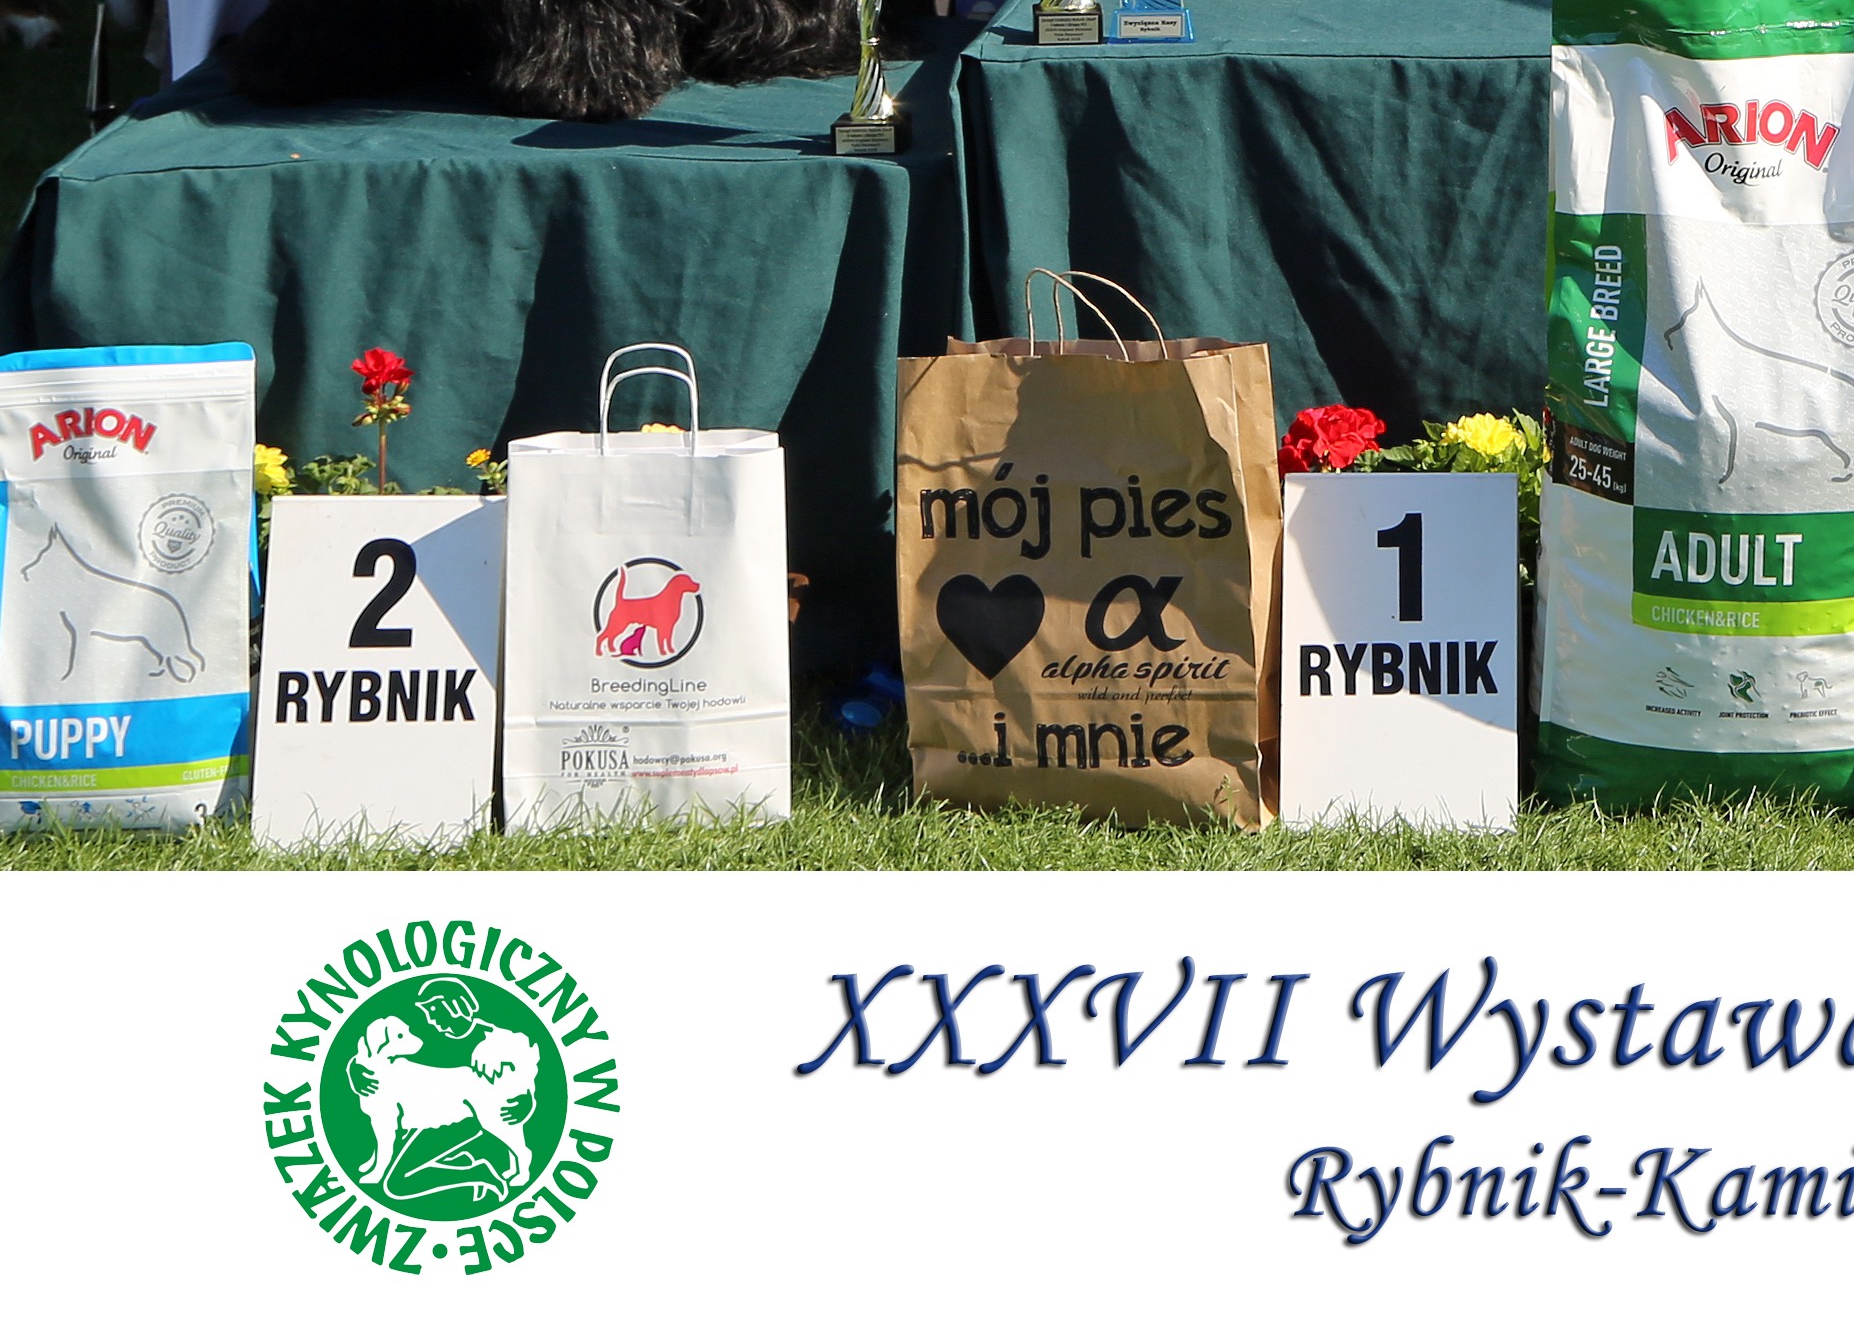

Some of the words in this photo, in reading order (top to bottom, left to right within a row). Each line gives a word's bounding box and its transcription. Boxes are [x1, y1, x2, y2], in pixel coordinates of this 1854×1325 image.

[1663, 99, 1841, 171] ARION
[1704, 152, 1783, 187] Original
[1590, 245, 1623, 321] BREED
[1584, 327, 1616, 408] LARGE
[28, 407, 158, 462] ARION
[1569, 436, 1588, 449] ADULT
[1588, 441, 1602, 454] DOG
[1602, 445, 1627, 462] WEIGHT
[63, 444, 118, 464] Original
[1569, 454, 1613, 489] 25-45
[161, 497, 206, 518] PREMIUM
[921, 462, 1052, 560] mój
[1079, 475, 1233, 558] pies
[151, 521, 201, 544] Quality
[149, 550, 193, 570] PRODUCT
[1377, 513, 1423, 622] 1
[1650, 530, 1803, 587] ADULT
[349, 538, 418, 648] 2
[1651, 606, 1760, 629] CHICKEN&RICE
[1041, 655, 1129, 686] alpha
[1134, 655, 1232, 689] spirit
[1299, 640, 1499, 696] RYBNIK
[275, 669, 478, 724] RYBNIK
[549, 700, 607, 711] Naturalne
[610, 701, 662, 712] wsparcie
[666, 699, 701, 712] Twojej
[702, 695, 746, 708] hodowli
[590, 678, 708, 695] BreedingLine
[1077, 686, 1108, 701] wild
[1111, 685, 1141, 701] and
[1144, 684, 1193, 704] perfect
[10, 714, 132, 761] PUPPY
[1036, 713, 1195, 769] mnie
[561, 750, 630, 771] POKUSA
[11, 773, 98, 788] CHICKEN&RICE
